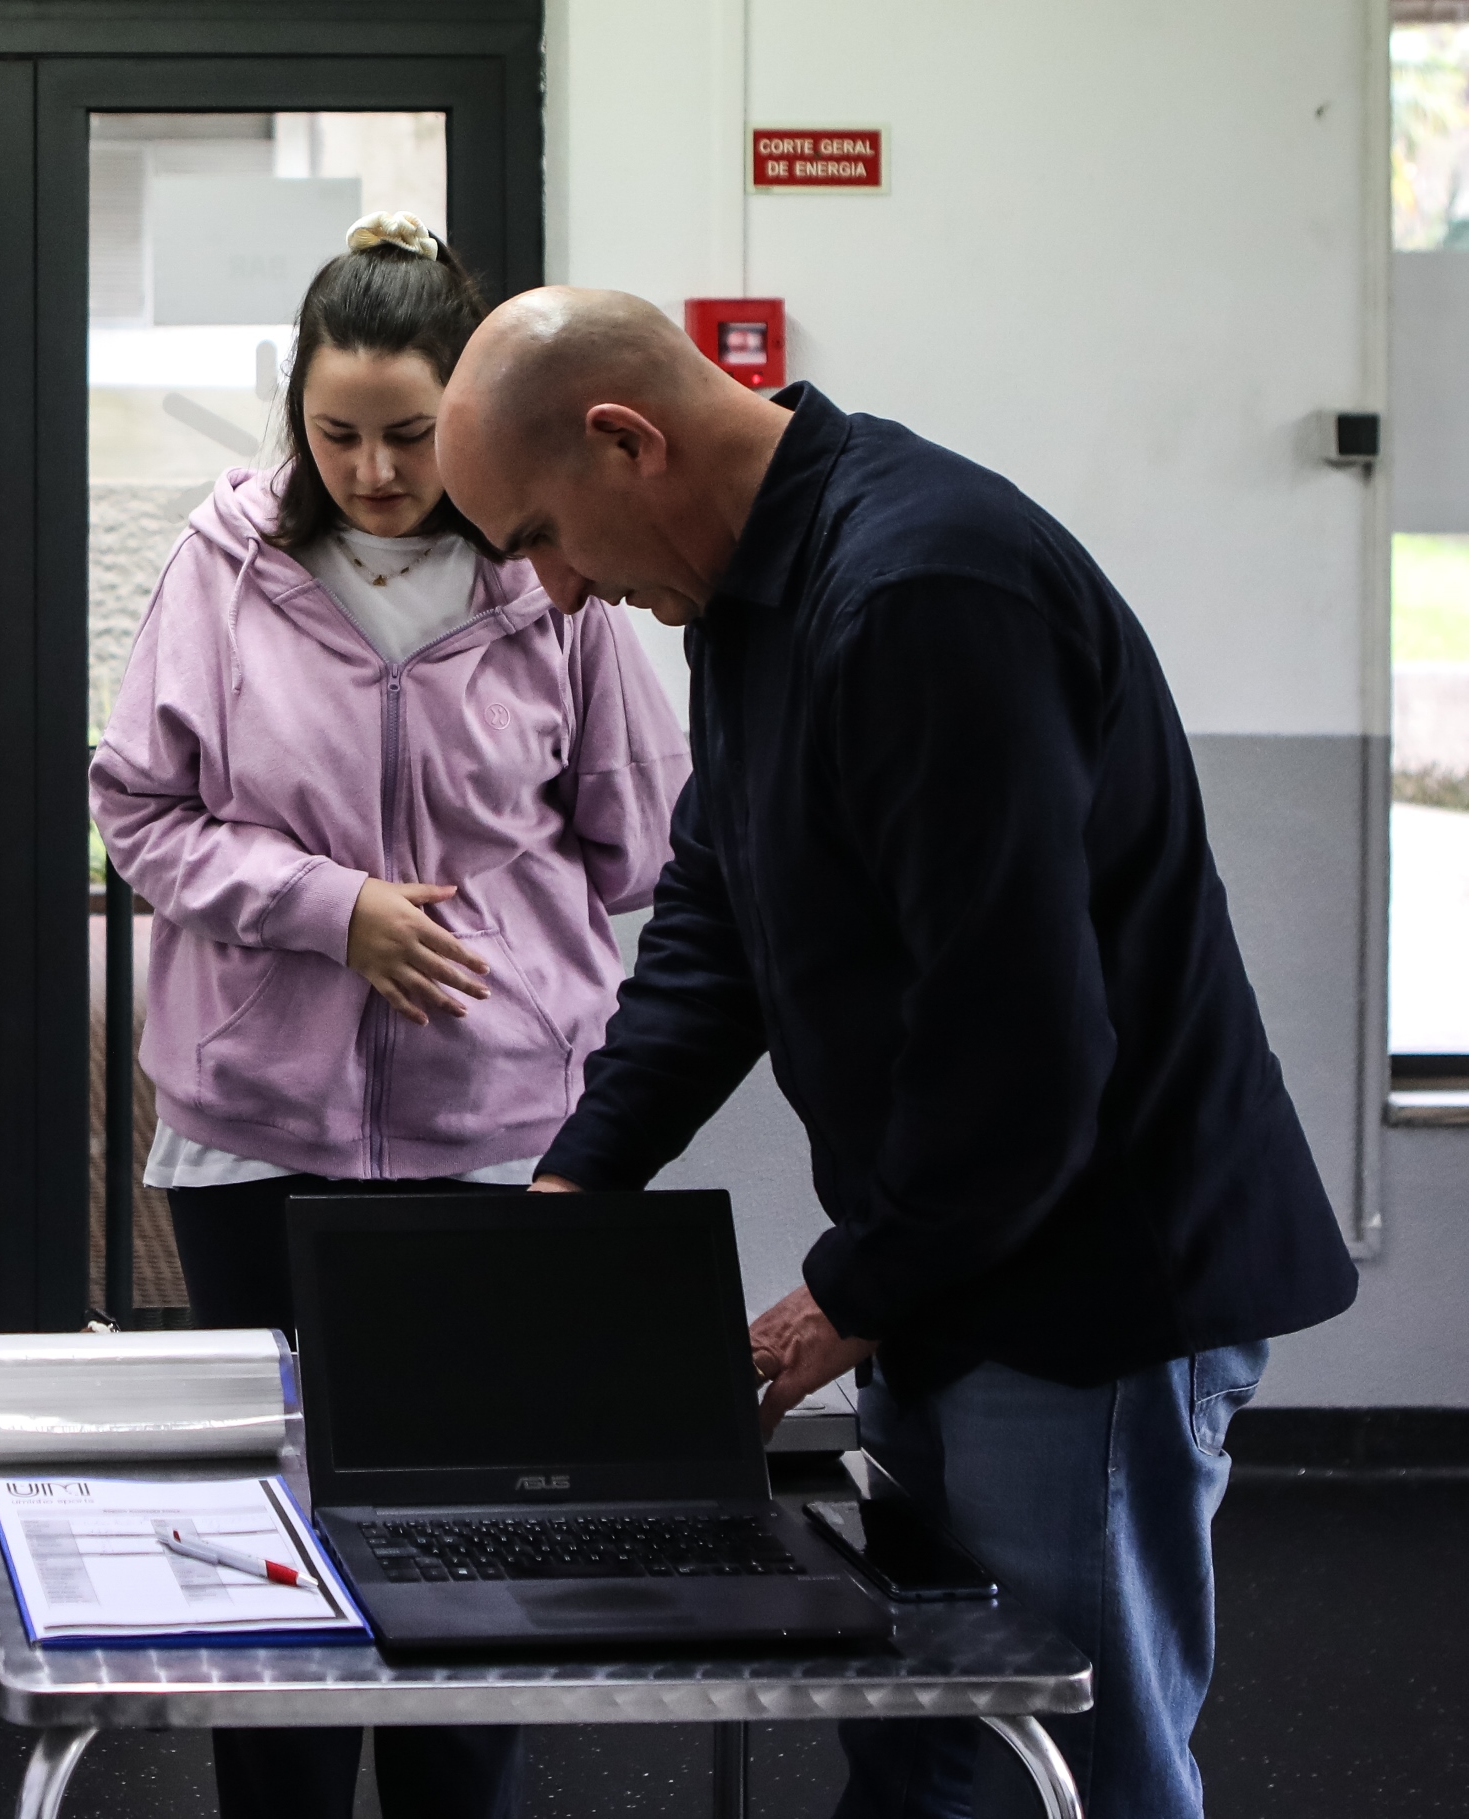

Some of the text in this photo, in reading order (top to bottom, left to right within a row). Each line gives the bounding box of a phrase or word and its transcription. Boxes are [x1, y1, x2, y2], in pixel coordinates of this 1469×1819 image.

[759, 137, 876, 155] CORTE GERAL
[767, 159, 867, 177] DE ENERGIA
[515, 1475, 570, 1490] ASUS
